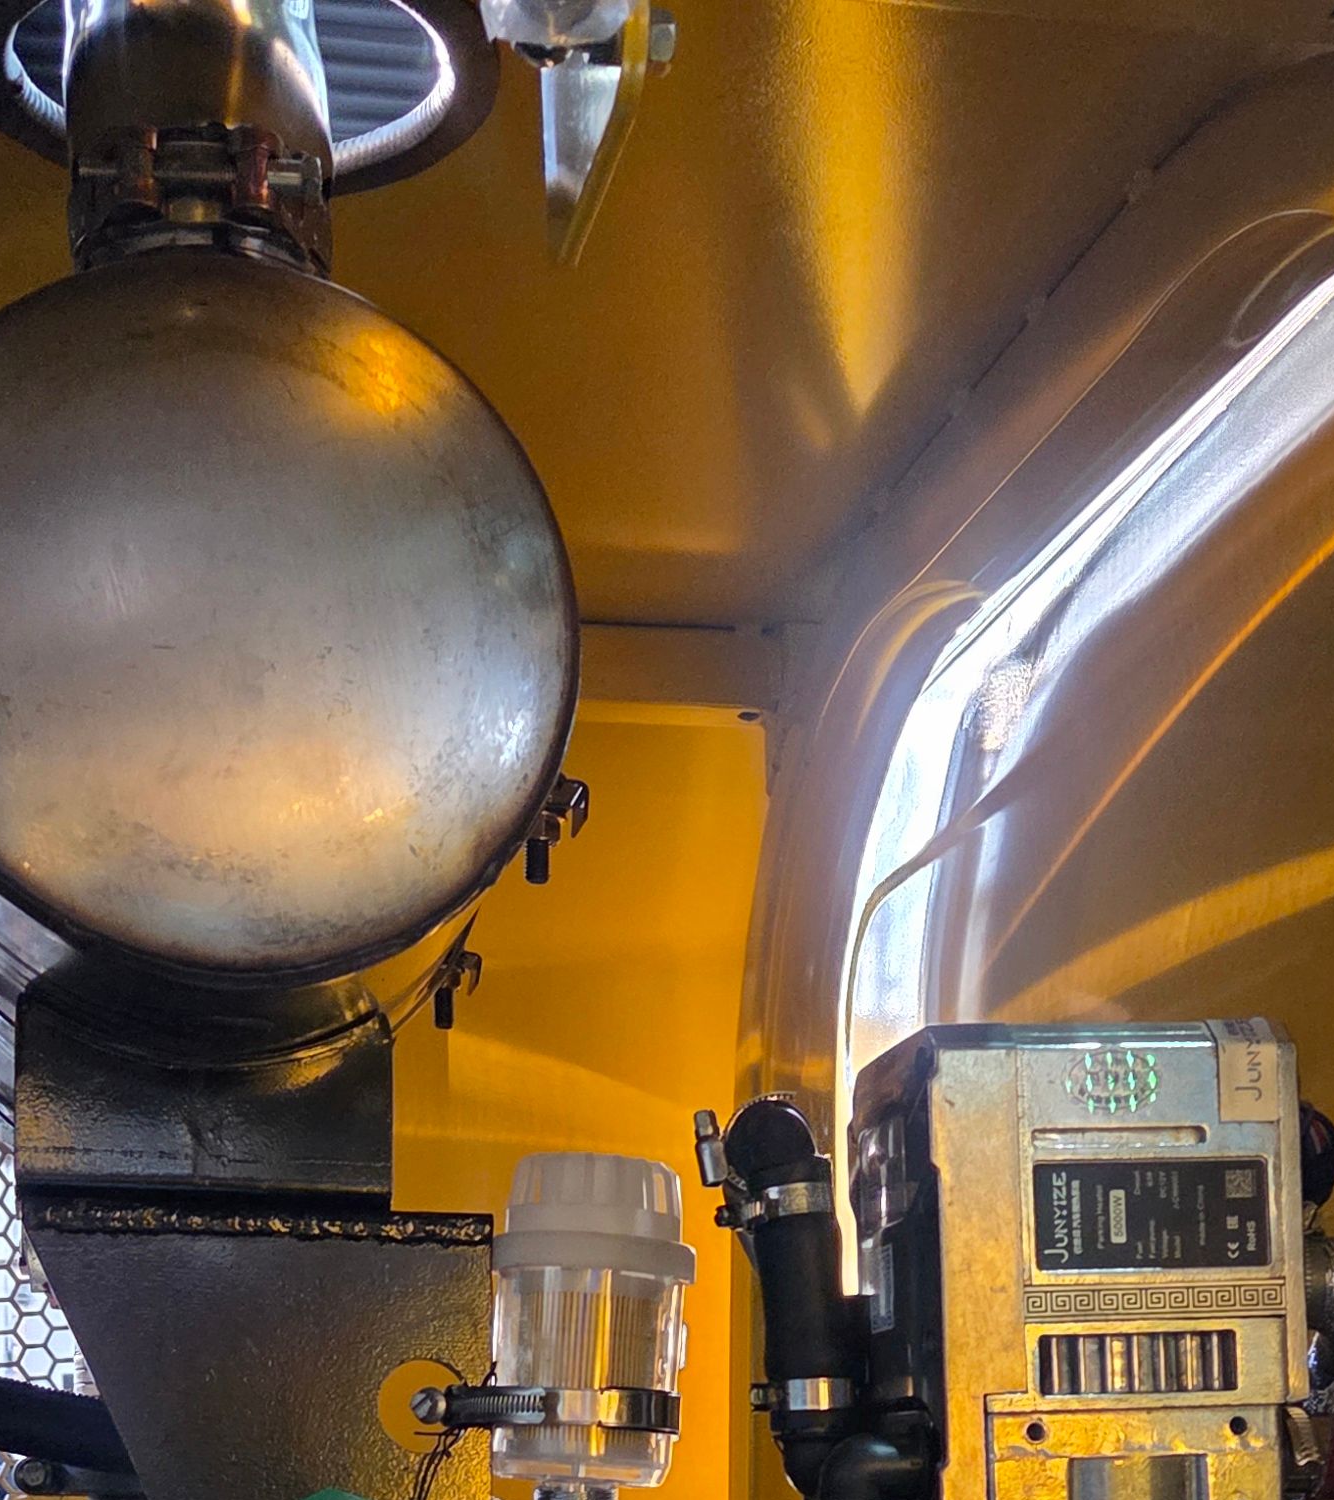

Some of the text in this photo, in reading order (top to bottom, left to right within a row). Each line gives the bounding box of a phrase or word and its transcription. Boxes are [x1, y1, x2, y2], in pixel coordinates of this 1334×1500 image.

[1095, 1185, 1105, 1249] Parking Heater
[1113, 1195, 1124, 1237] 5000W
[1246, 1221, 1257, 1251] RoHS
